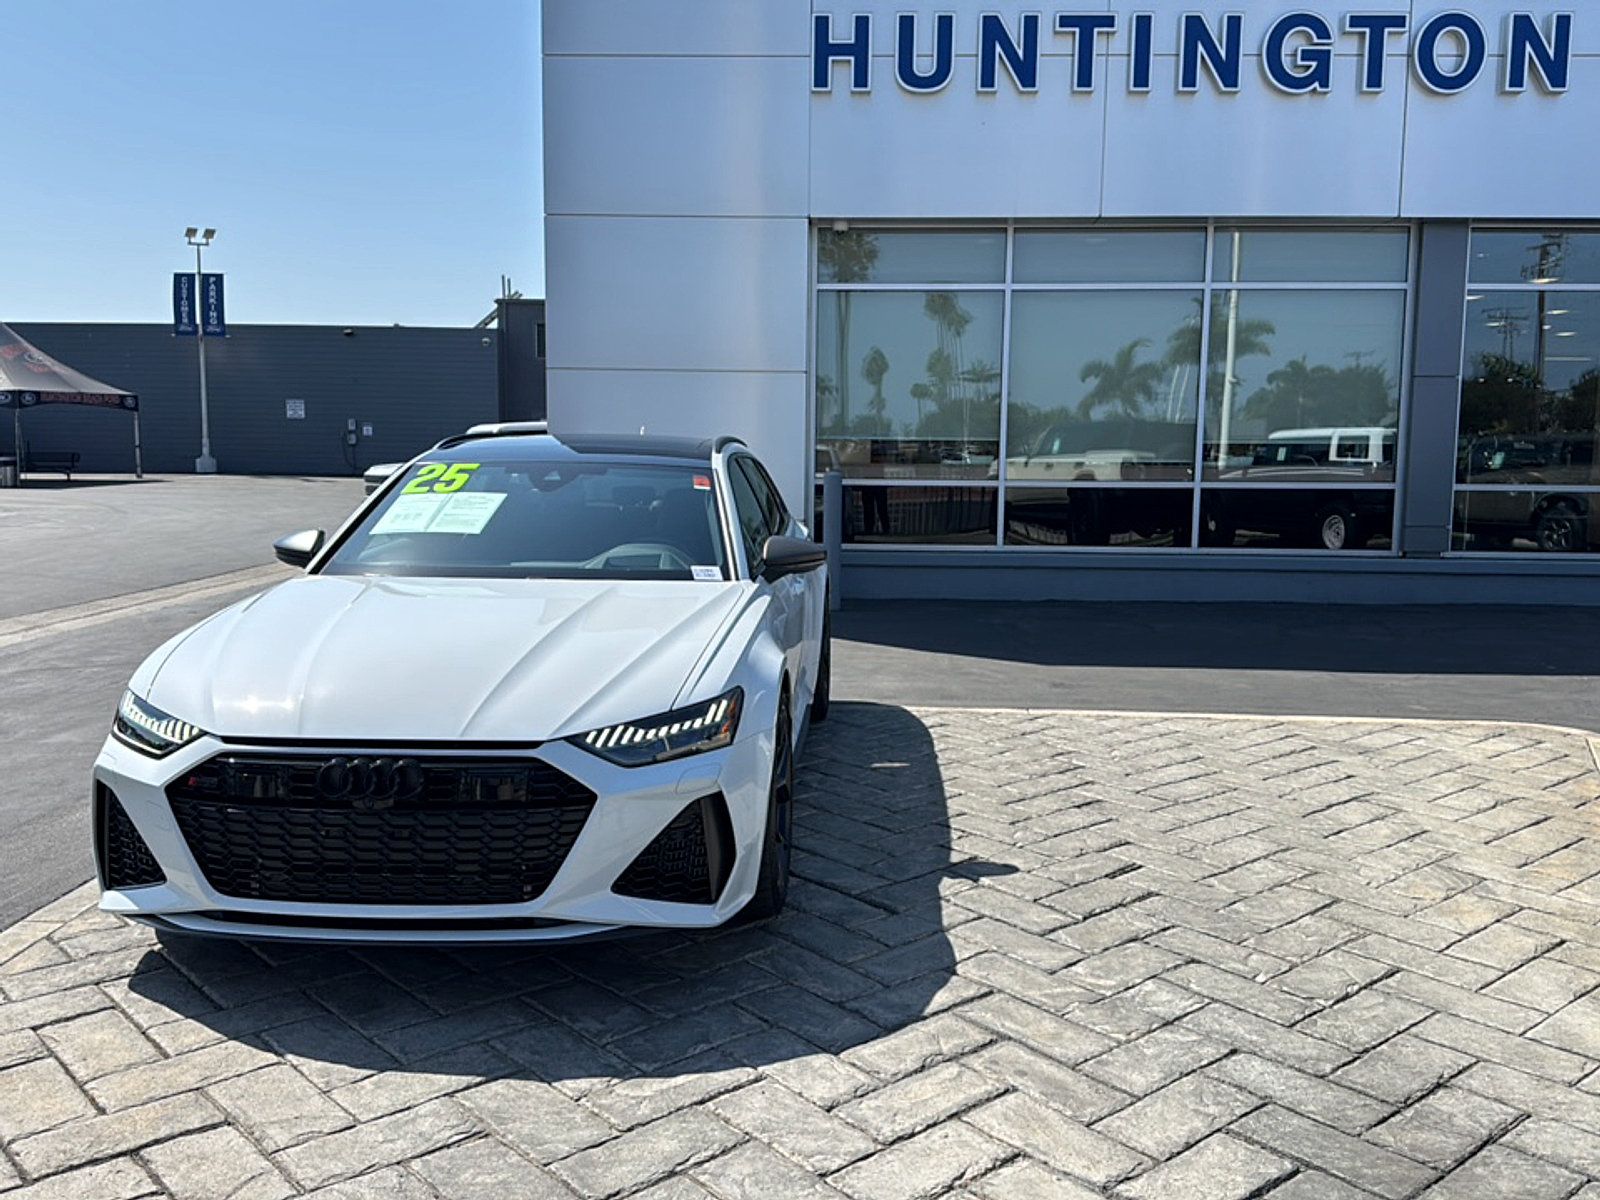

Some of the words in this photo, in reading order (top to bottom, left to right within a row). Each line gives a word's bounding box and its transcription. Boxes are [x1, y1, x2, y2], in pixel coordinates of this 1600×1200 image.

[811, 10, 1575, 95] HUNTINGTON
[181, 276, 189, 324] CUSTOMER
[208, 276, 217, 325] PARKING
[401, 462, 480, 494] 25
